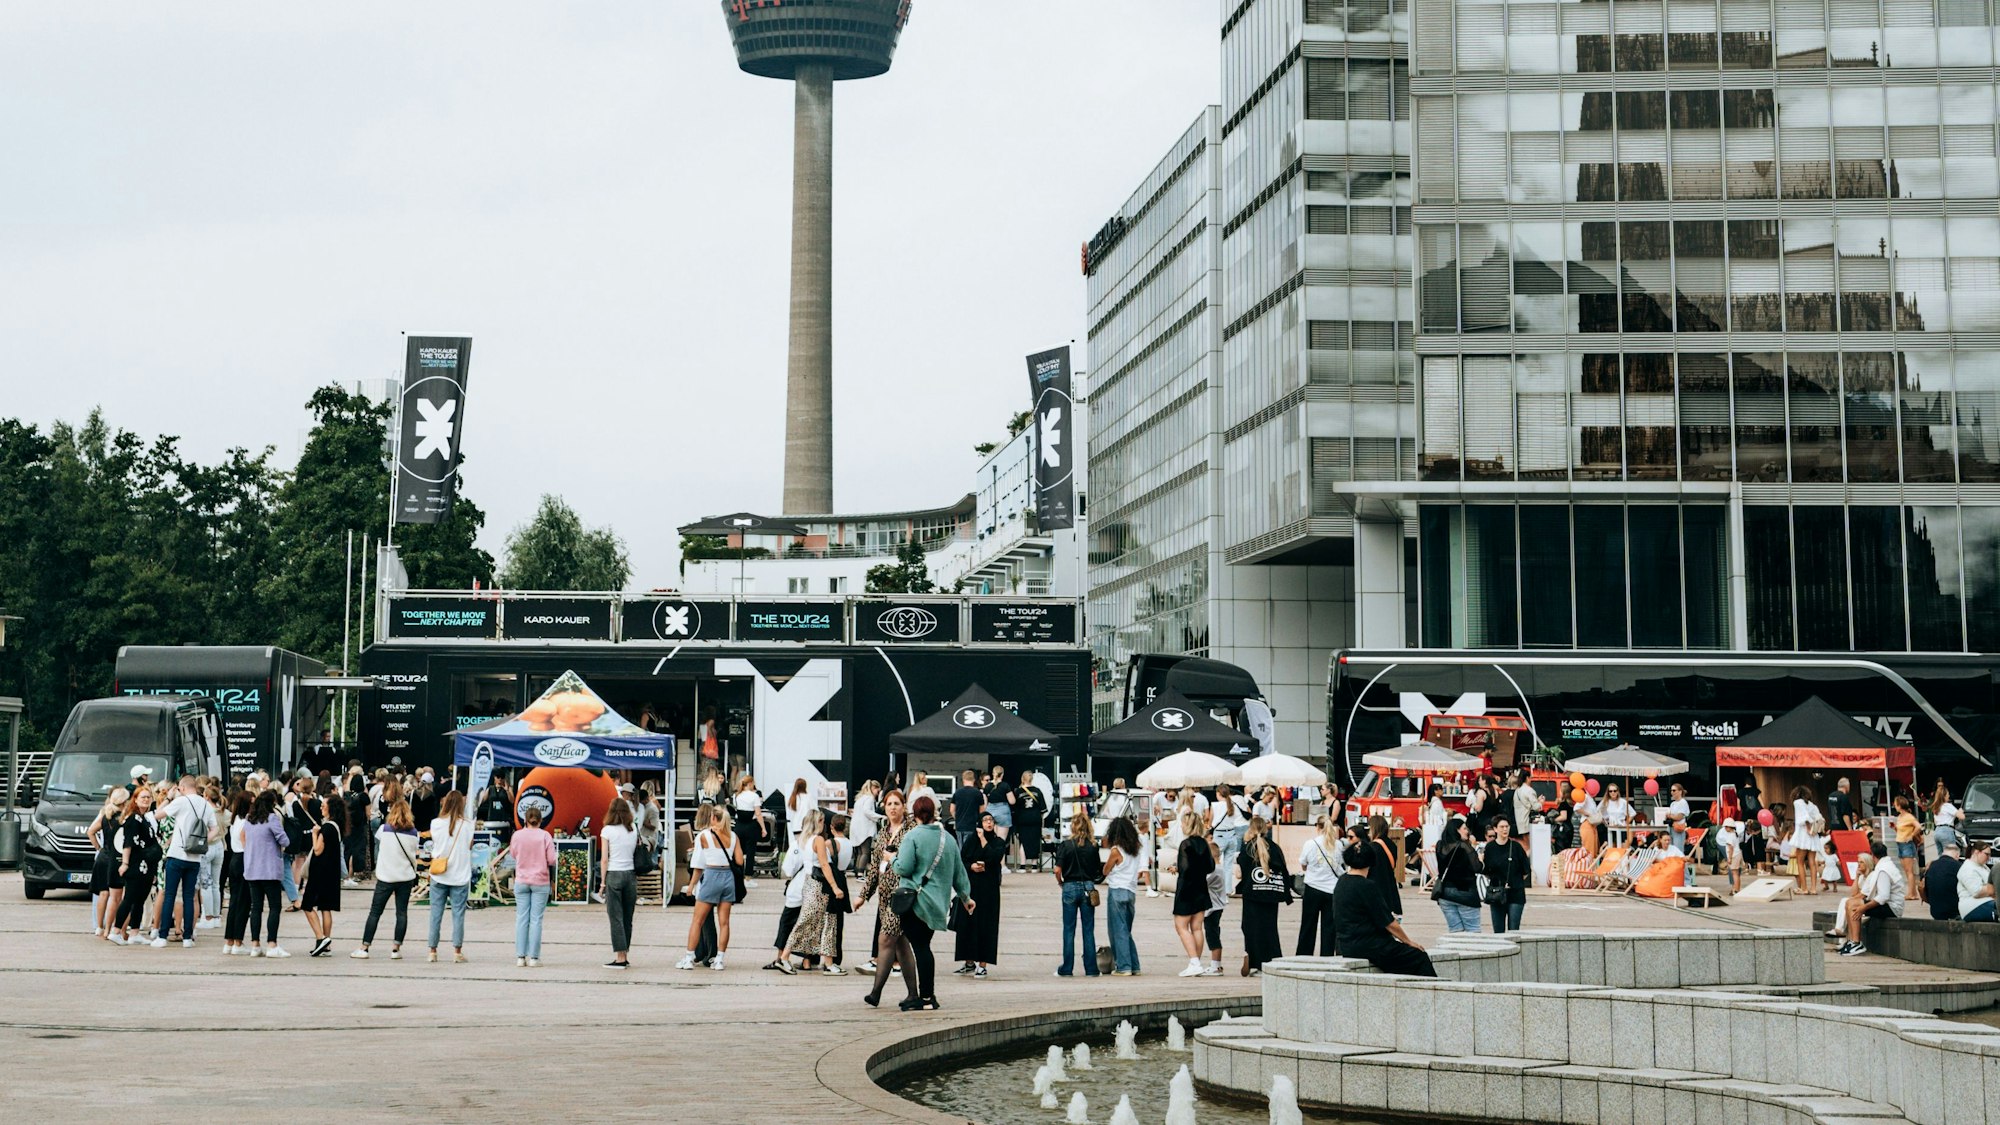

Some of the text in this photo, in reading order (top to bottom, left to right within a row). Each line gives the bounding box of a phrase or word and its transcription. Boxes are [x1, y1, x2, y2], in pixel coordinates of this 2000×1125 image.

[401, 610, 486, 619] TOGETHER WE MOVE
[750, 614, 777, 624] THE
[444, 618, 483, 626] CHAPTER
[524, 616, 590, 624] KARO KAUER
[539, 743, 587, 760] SanLucar
[604, 748, 624, 757] Taste
[625, 749, 638, 757] the
[1748, 753, 1800, 761] GERMANY
